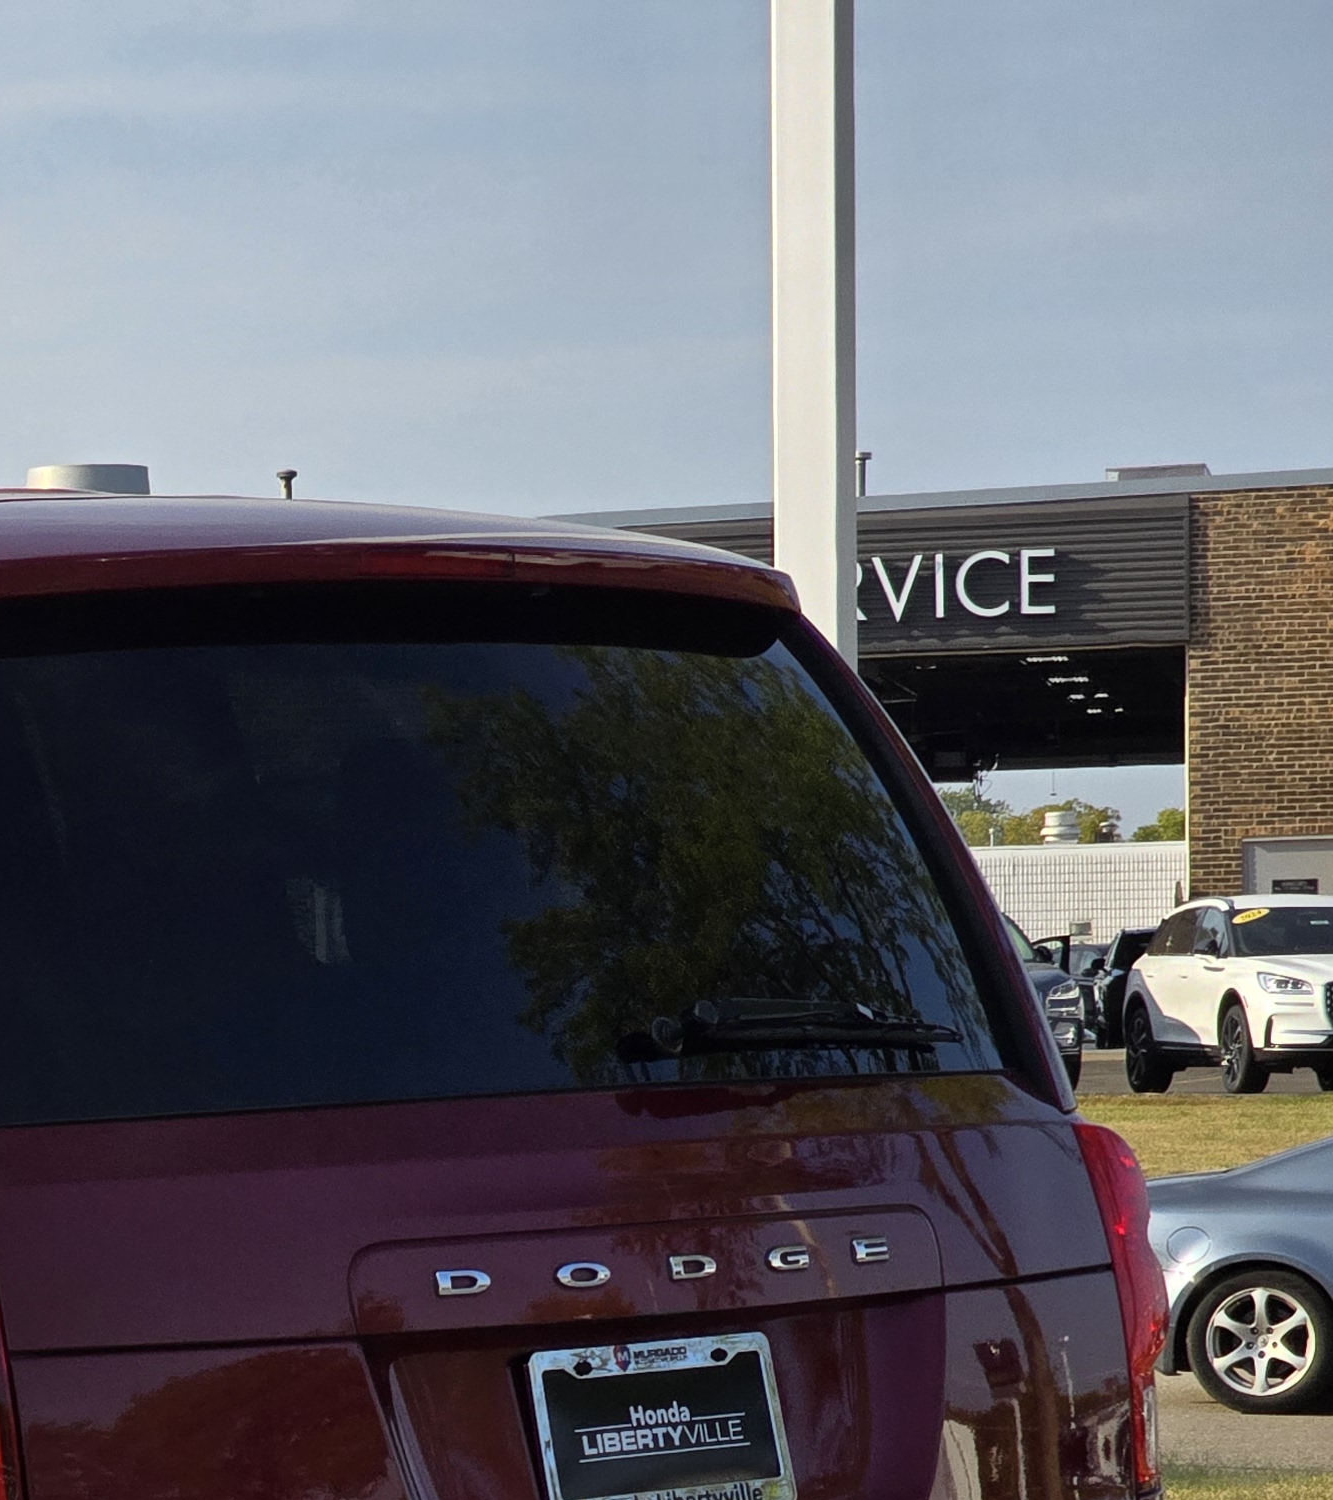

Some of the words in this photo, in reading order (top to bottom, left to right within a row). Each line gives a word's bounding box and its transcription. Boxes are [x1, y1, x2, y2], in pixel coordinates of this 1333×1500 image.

[434, 1236, 890, 1296] DODGE
[629, 1400, 691, 1426] Honda
[582, 1419, 744, 1456] LIBERTYVILLE
